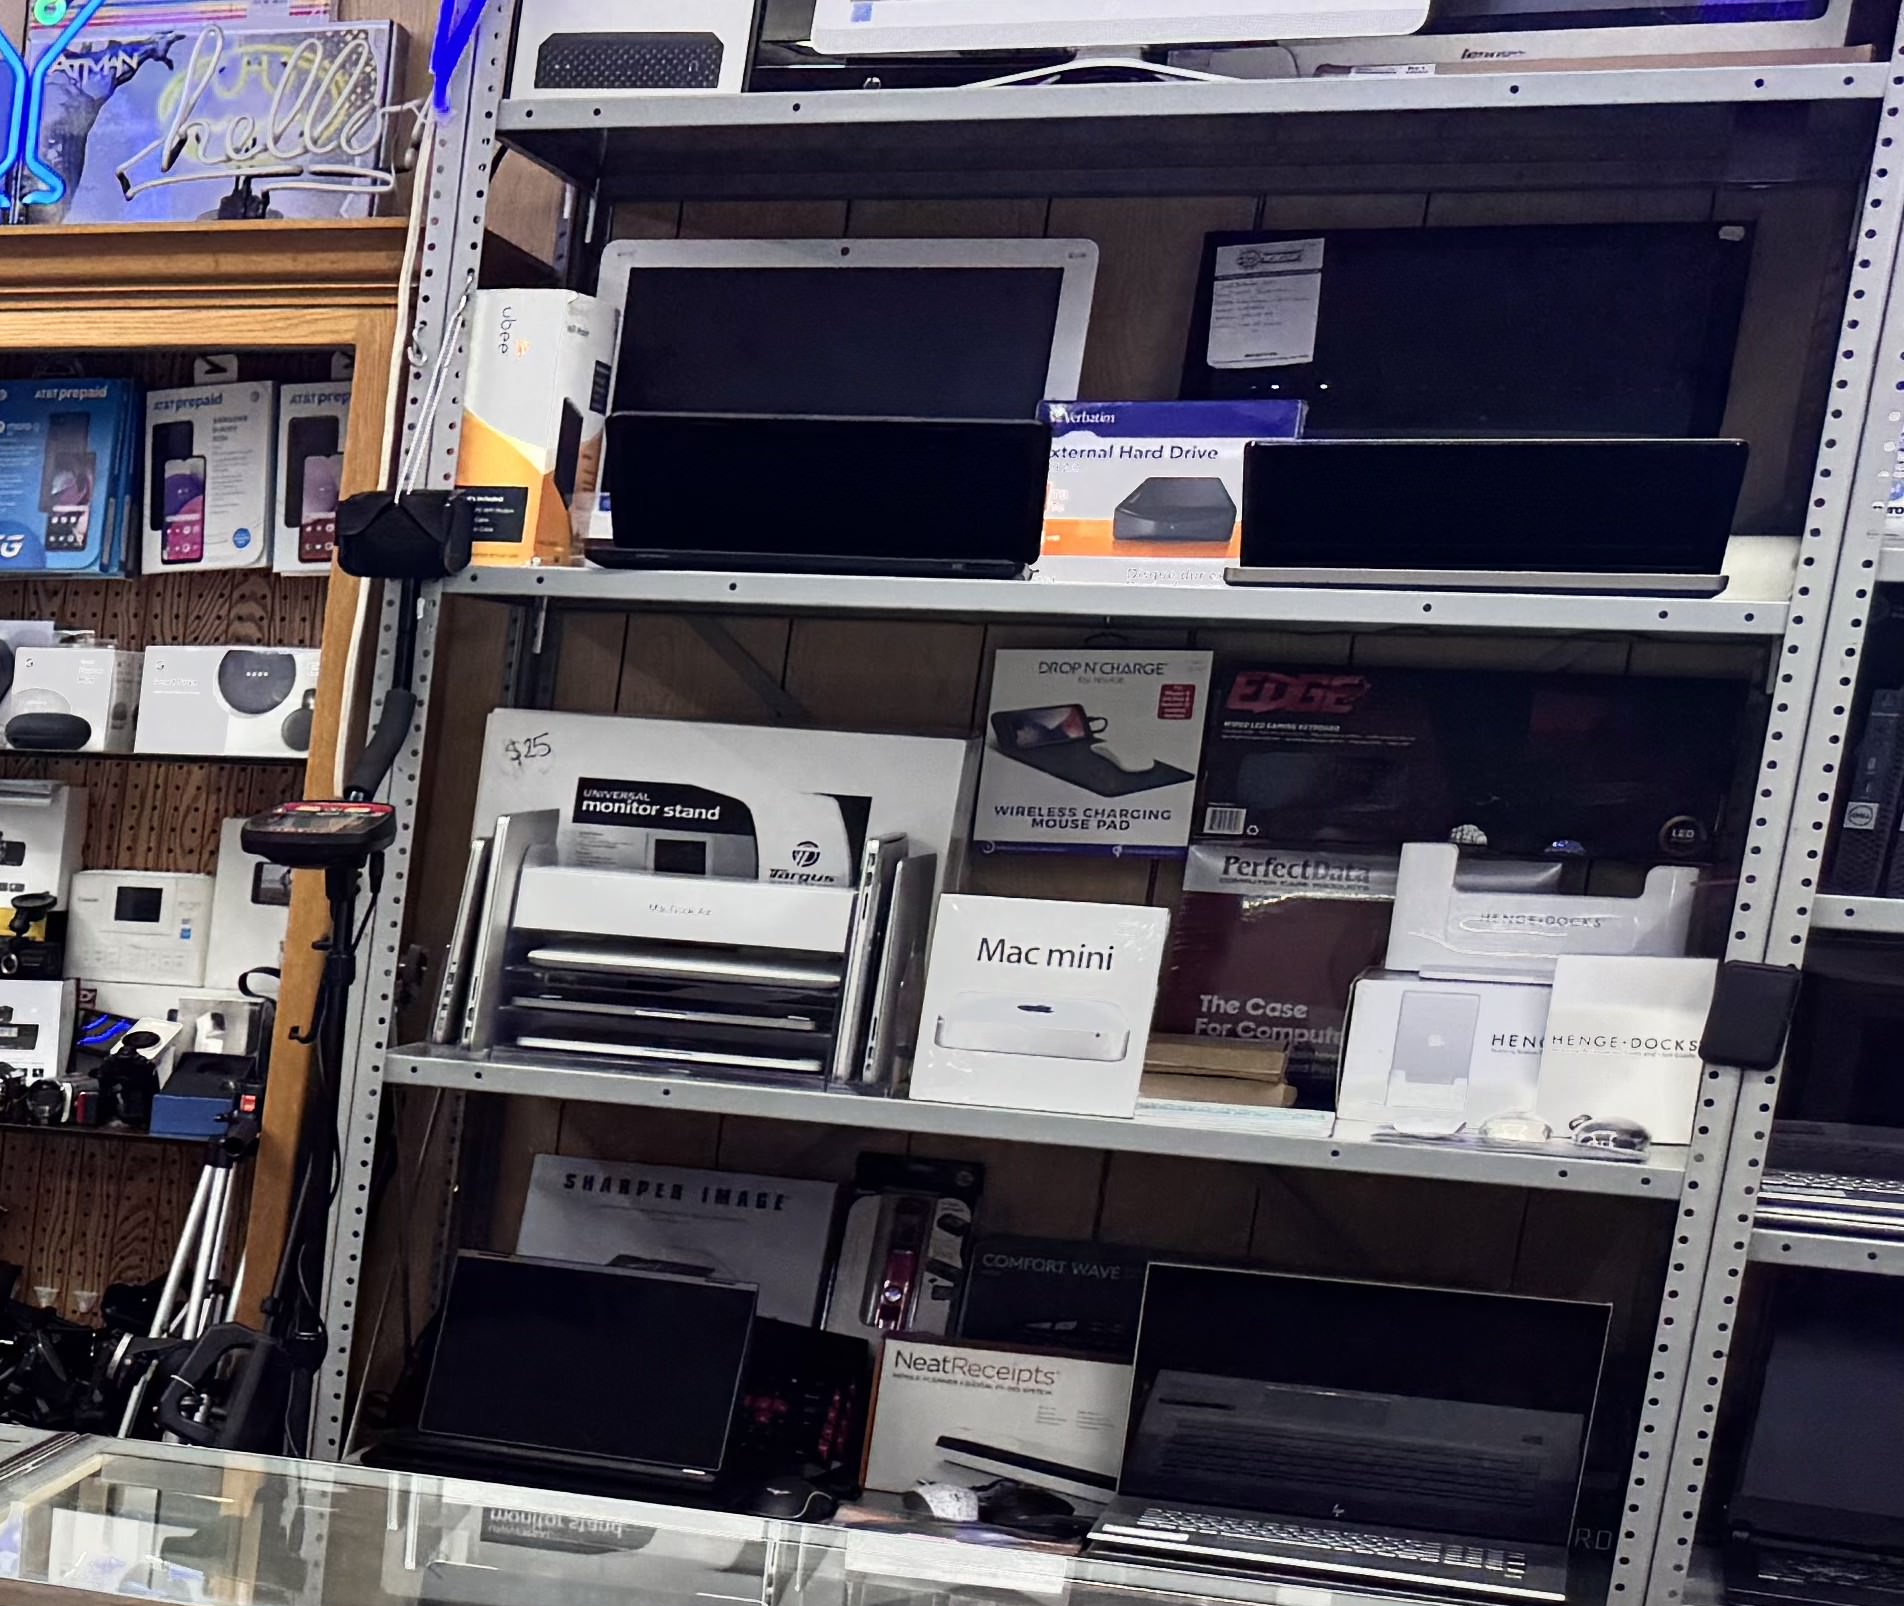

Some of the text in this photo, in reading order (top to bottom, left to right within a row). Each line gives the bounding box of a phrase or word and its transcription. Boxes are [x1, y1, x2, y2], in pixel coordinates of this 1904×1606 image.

[162, 25, 384, 172] hello
[498, 305, 513, 356] ubee
[60, 386, 107, 401] prepaid
[175, 394, 223, 412] prepaid
[1050, 444, 1219, 460] xternal Hard Drive
[1039, 662, 1165, 676] DROP CHARGE
[1226, 672, 1366, 713] EDGE
[504, 732, 553, 769] $25
[582, 788, 651, 801] UNIVERSAL
[581, 798, 721, 821] monitor stand
[994, 804, 1172, 822] WIRELESS CHARGING
[1030, 817, 1131, 832] MOUSE PAD
[769, 868, 835, 884] Targus
[1223, 855, 1371, 885] PerfectData
[977, 937, 1115, 972] Mac mini
[1199, 993, 1308, 1019] The Case
[1194, 1017, 1233, 1037] For
[563, 1172, 786, 1212] SHARPER IMAGE
[982, 1253, 1122, 1281] COMFORT WAVE
[894, 1349, 1056, 1387] NeatReceipts
